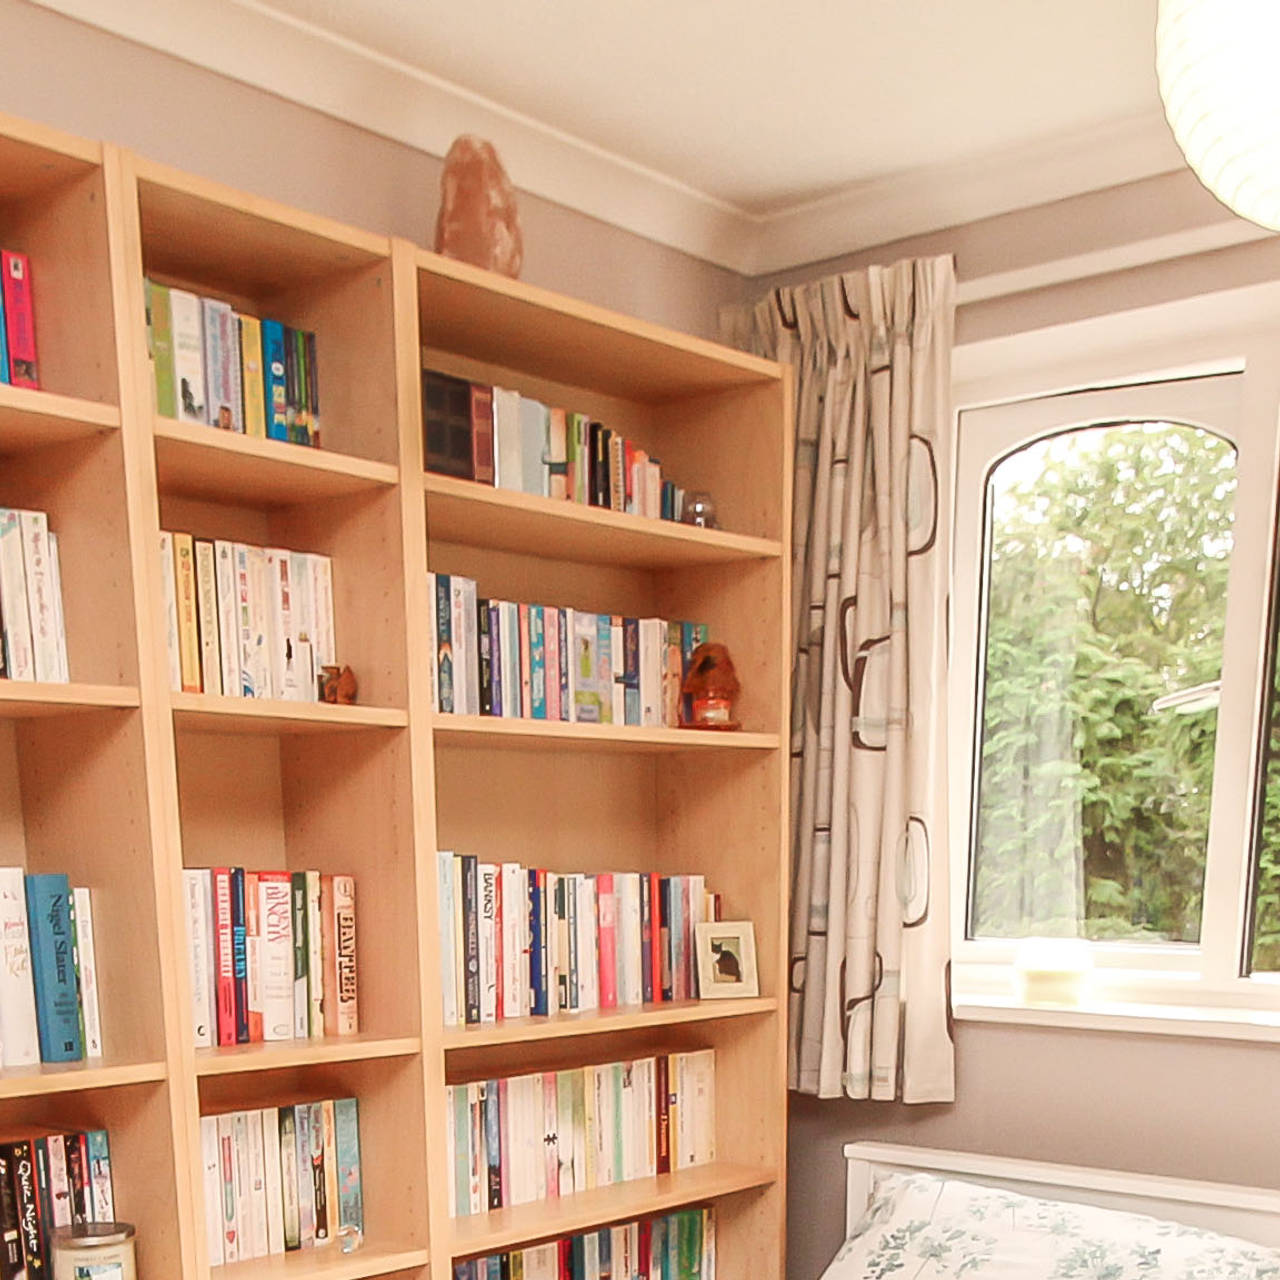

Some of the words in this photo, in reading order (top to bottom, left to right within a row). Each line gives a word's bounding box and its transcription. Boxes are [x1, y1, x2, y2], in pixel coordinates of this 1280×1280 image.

[47, 893, 65, 936] Nigel
[264, 886, 283, 943] BINCHY
[483, 872, 494, 921] BANKSY
[54, 940, 70, 985] Slater
[20, 1202, 38, 1254] Night
